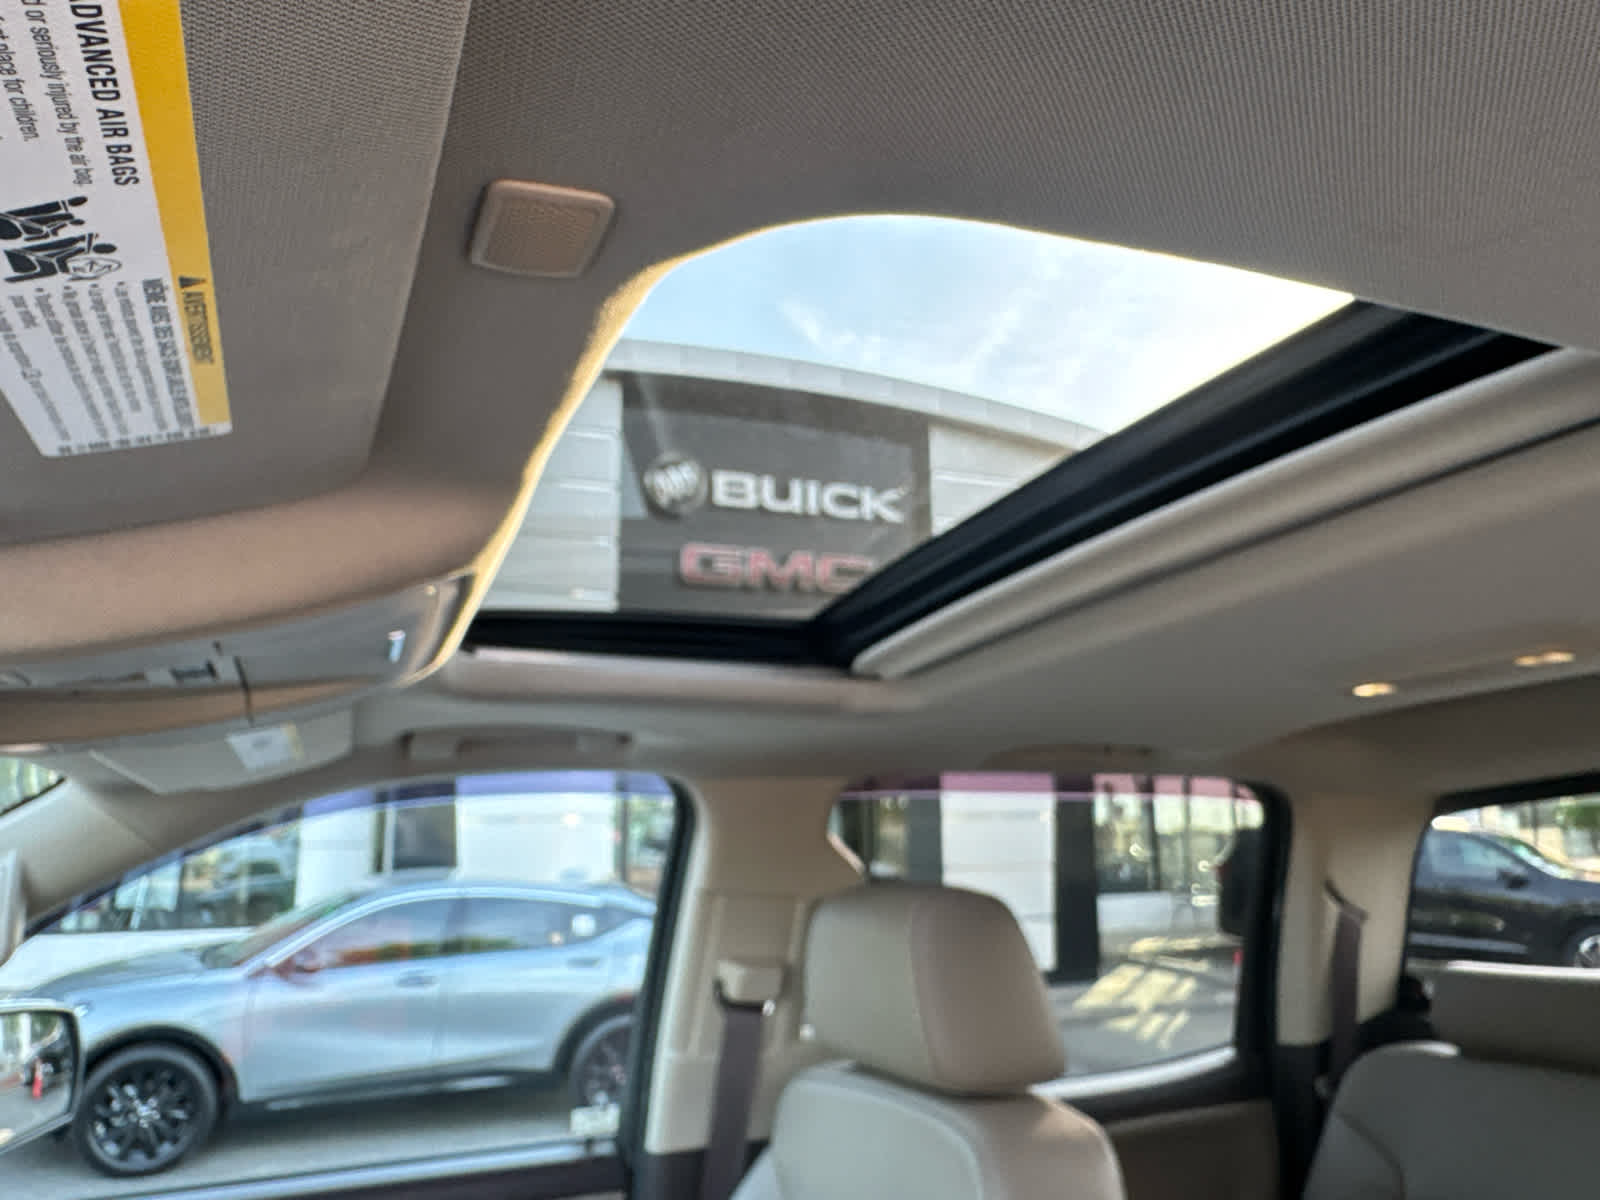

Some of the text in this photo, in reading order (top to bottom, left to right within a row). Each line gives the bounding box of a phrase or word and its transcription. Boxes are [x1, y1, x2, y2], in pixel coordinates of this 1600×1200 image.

[25, 10, 47, 24] or
[30, 27, 65, 80] seriously
[3, 78, 25, 94] for
[45, 82, 79, 120] injured
[69, 0, 140, 186] DVANCED AIR BAGS
[56, 122, 80, 134] by
[711, 470, 906, 524] BUICK
[679, 542, 878, 592] GMC
